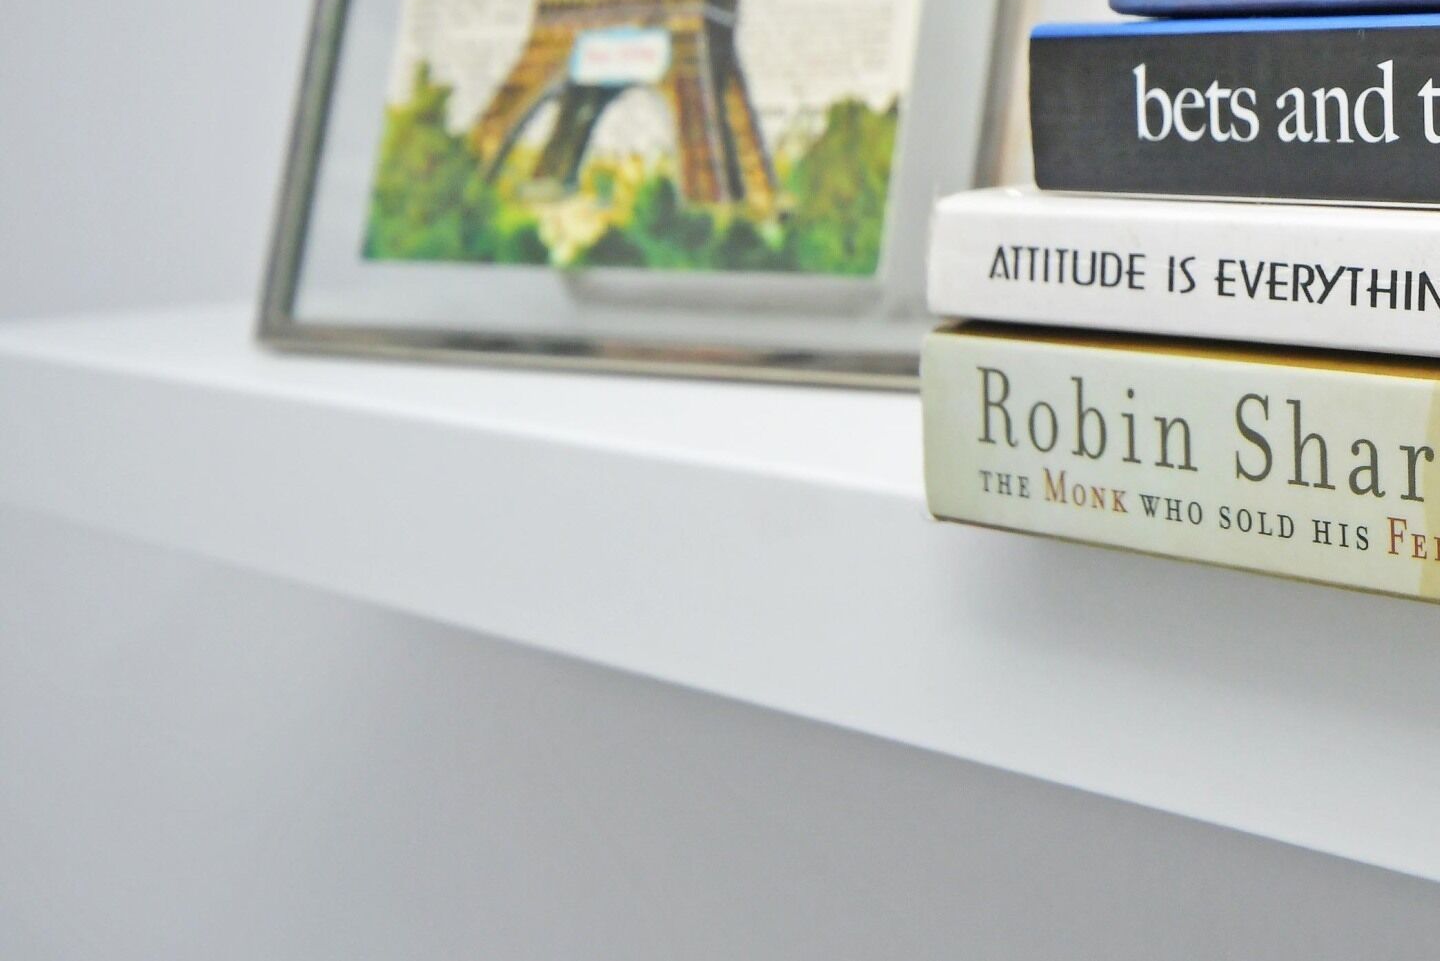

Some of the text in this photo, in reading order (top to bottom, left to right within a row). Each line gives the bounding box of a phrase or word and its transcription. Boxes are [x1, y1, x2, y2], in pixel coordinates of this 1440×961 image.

[1132, 62, 1260, 142] bets
[1275, 59, 1400, 144] and
[988, 245, 1146, 291] ATTITUDE
[1167, 256, 1196, 294] IS
[976, 366, 1198, 472] Robin
[979, 470, 1031, 499] THE
[1139, 494, 1203, 525] WHO
[1219, 506, 1295, 539] SOLD
[1312, 519, 1369, 551] HIS
